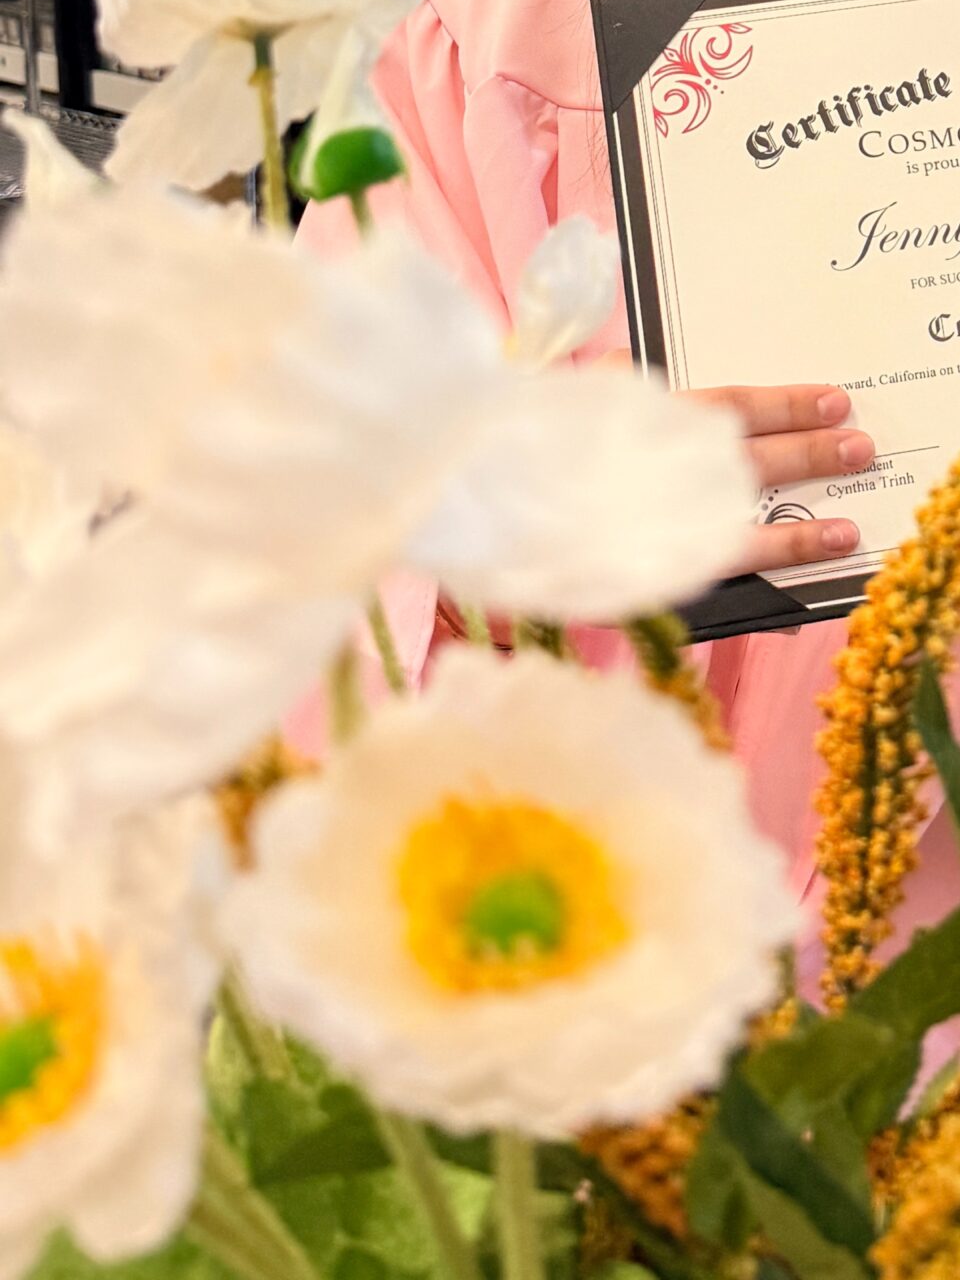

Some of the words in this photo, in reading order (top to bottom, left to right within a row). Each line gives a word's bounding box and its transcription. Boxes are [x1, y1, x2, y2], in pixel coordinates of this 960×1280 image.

[746, 68, 952, 169] Certificate
[906, 161, 919, 174] is
[910, 277, 937, 289] FOR
[836, 376, 876, 390] ward,
[879, 367, 937, 385] California
[939, 366, 954, 376] on
[843, 460, 894, 476] ident
[826, 479, 876, 499] Cynthia
[879, 472, 915, 489] Trinh
